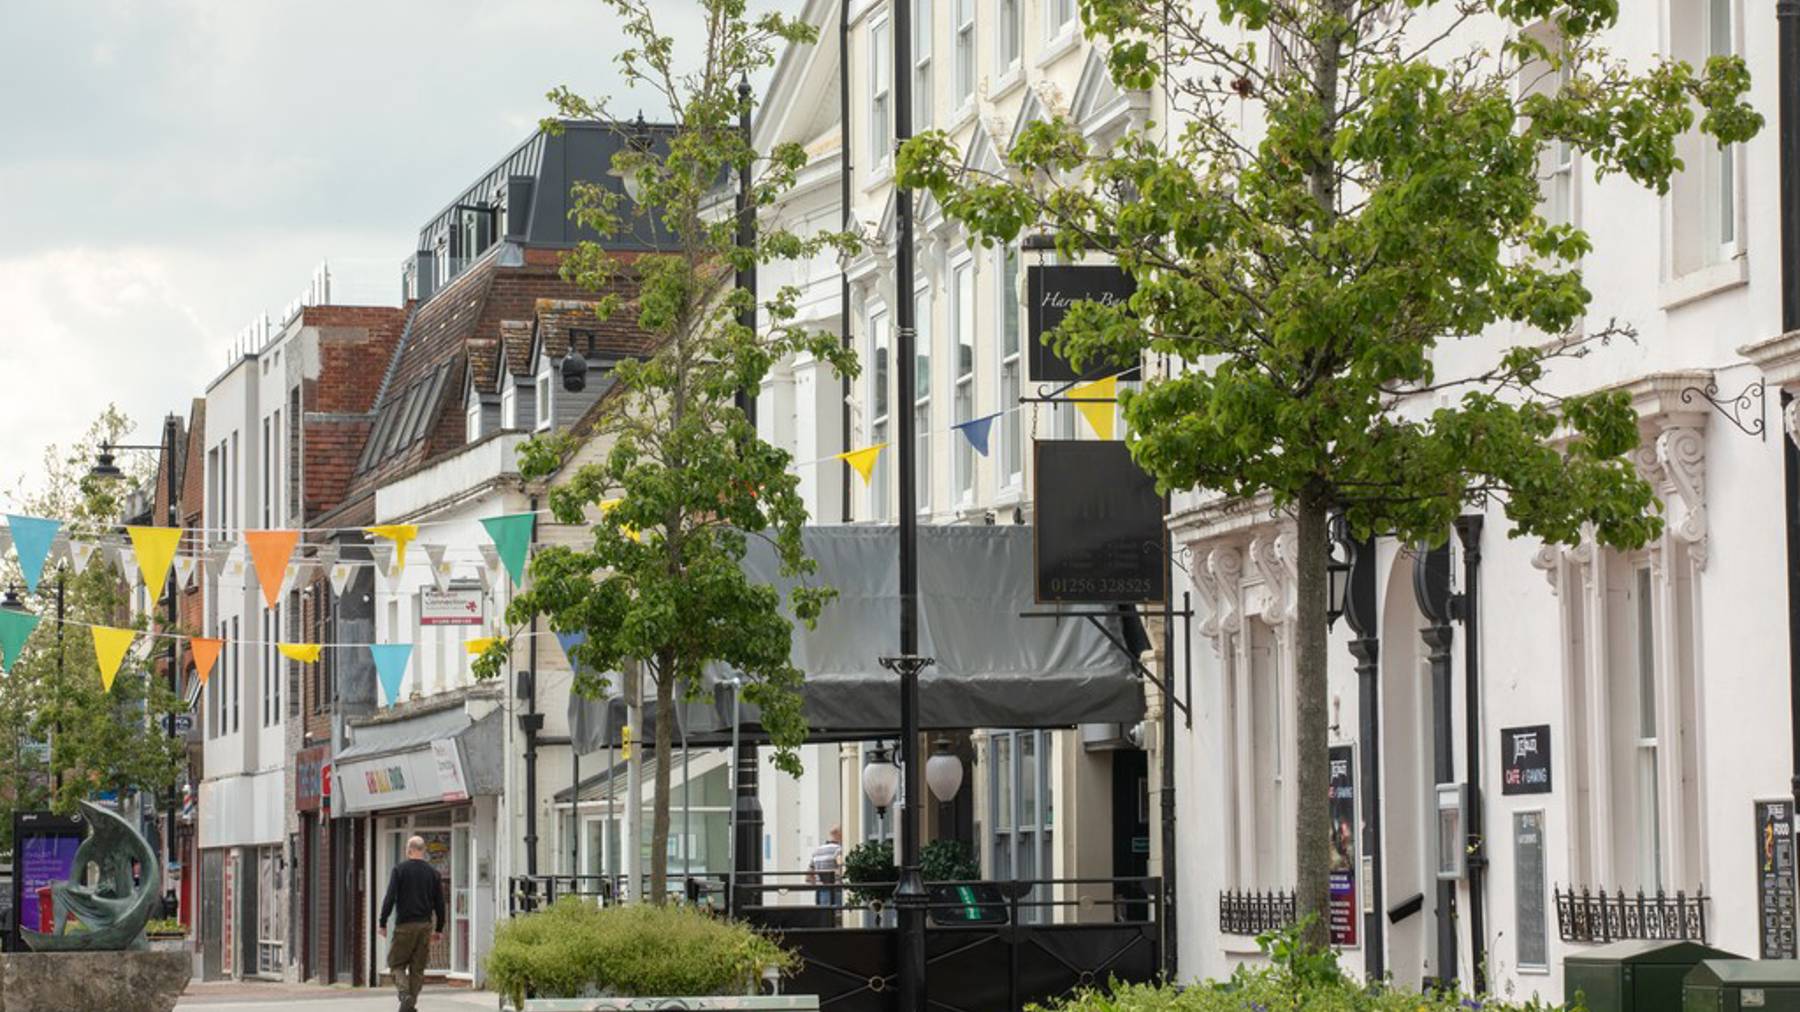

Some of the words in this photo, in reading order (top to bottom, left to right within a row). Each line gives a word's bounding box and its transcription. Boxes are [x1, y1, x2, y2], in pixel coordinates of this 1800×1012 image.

[1051, 577, 1096, 593] 01256
[1099, 577, 1152, 593] 328525
[1505, 768, 1521, 785] CAFE
[1526, 767, 1547, 784] GAMING
